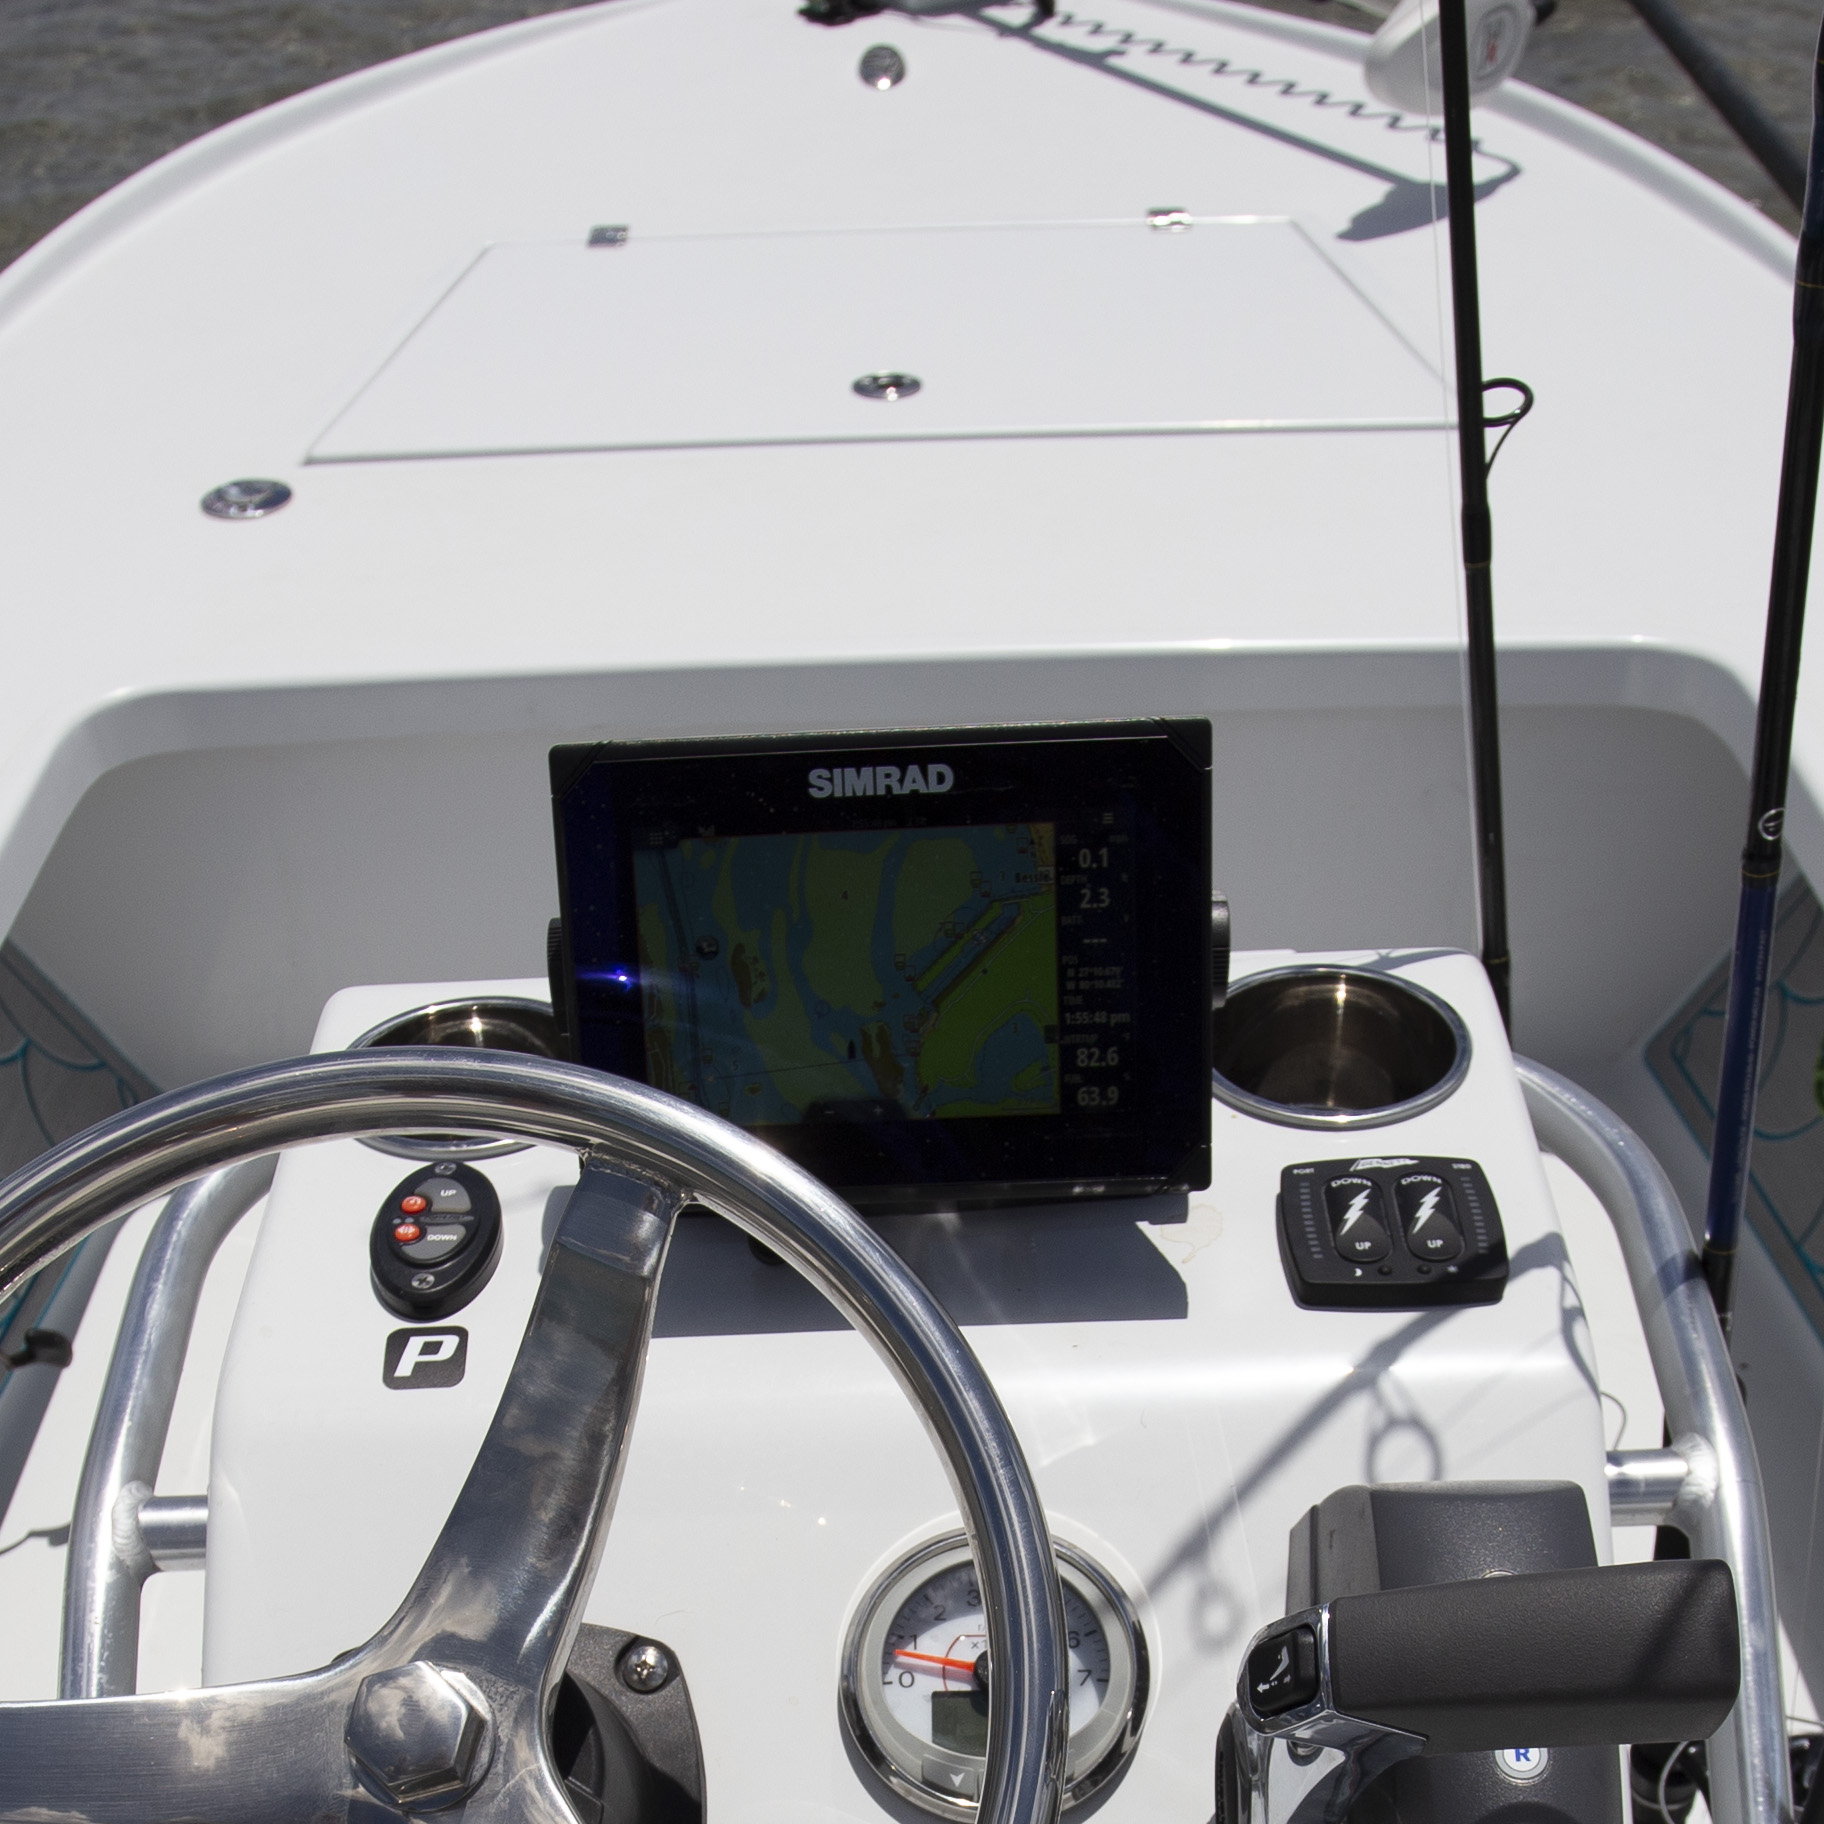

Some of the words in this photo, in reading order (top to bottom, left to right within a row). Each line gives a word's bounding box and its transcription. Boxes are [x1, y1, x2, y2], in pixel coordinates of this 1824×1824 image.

[807, 764, 955, 799] SIMRAD
[1079, 847, 1108, 868] 0.1
[1080, 887, 1111, 909] 2.3
[1110, 1013, 1131, 1027] pm
[1076, 1046, 1119, 1067] 82.6
[1077, 1085, 1119, 1107] 63.9
[1292, 1167, 1315, 1175] PORT
[1331, 1178, 1372, 1187] DOWN
[1400, 1175, 1443, 1186] DOWN
[440, 1189, 457, 1197] UP
[427, 1233, 457, 1241] DOWN
[1426, 1239, 1443, 1248] UP
[1354, 1241, 1371, 1250] UP
[393, 1334, 460, 1377] P
[967, 1589, 980, 1607] 3
[932, 1604, 947, 1622] 2
[910, 1634, 919, 1650] 1
[898, 1671, 915, 1688] 0
[1076, 1669, 1092, 1687] 7
[1514, 1748, 1531, 1762] R
